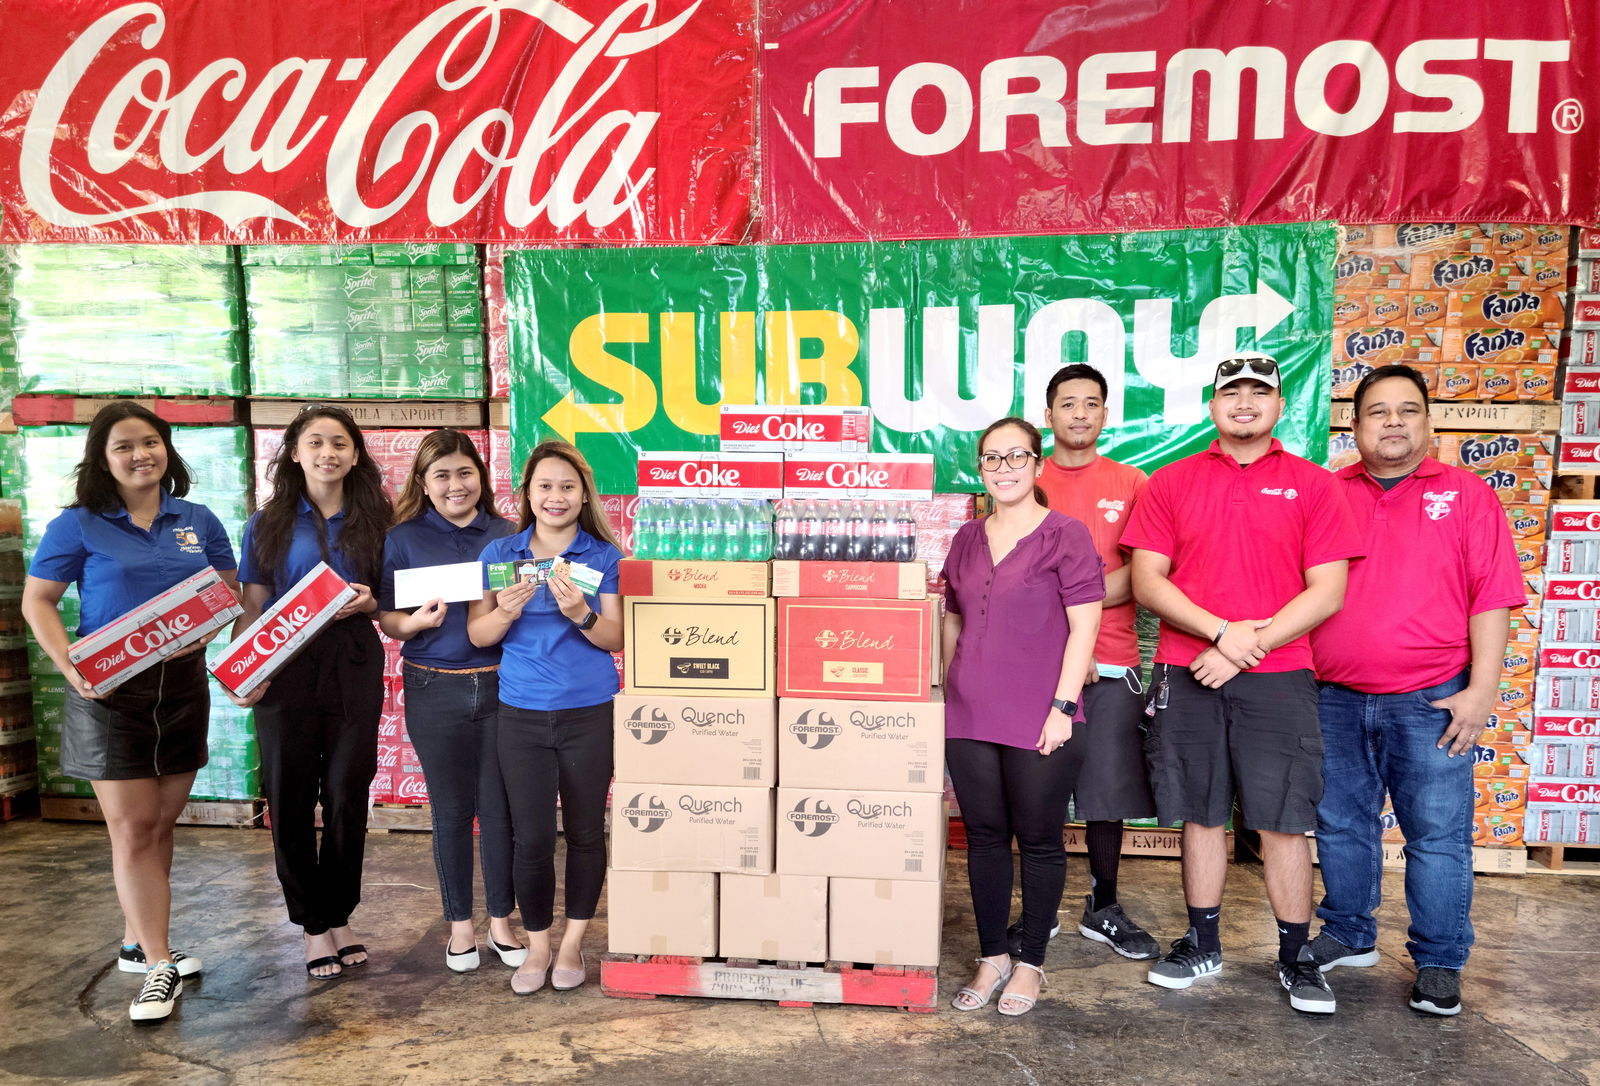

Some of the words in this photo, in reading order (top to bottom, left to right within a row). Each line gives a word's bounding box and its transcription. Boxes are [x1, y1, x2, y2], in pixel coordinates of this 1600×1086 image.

[812, 38, 1571, 159] FOREMOST
[19, 0, 700, 229] Coca-Cola
[1499, 232, 1524, 245] Fanta
[1537, 233, 1563, 246] Fanta
[1433, 255, 1494, 288] Fanta
[1535, 270, 1560, 282] Fanta
[345, 277, 374, 290] Sprite
[1375, 304, 1399, 315] Fanta
[1414, 304, 1439, 316] Fanta
[1482, 291, 1540, 320] Fanta
[348, 309, 378, 322] Sprite
[417, 342, 446, 357] Sprite
[1345, 328, 1405, 358] Fanta
[1466, 328, 1525, 359] Fanta
[541, 277, 1297, 435] SUBWAY
[419, 377, 448, 391] Sprite
[1446, 378, 1470, 389] Fanta
[1485, 378, 1509, 389] Fanta
[1524, 378, 1548, 390] Fanta
[1575, 377, 1597, 388] Diet
[390, 408, 446, 421] EXPORT
[732, 420, 760, 434] Diet
[762, 415, 825, 440] Coke
[1460, 435, 1520, 465] Fanta
[1570, 447, 1593, 458] Diet
[649, 467, 677, 480] Diet
[678, 462, 741, 486] Coke
[796, 468, 824, 481] Diet
[825, 463, 890, 488] Coke
[1484, 469, 1516, 490] nta
[1514, 518, 1539, 530] Fanta
[1561, 516, 1584, 527] Diet
[489, 564, 507, 572] Free
[683, 567, 719, 582] Blend
[838, 569, 876, 583] Blend
[1553, 585, 1577, 596] Diet
[1578, 581, 1600, 599] Co
[95, 650, 126, 672] Diet
[124, 613, 196, 657] Coke
[230, 651, 257, 675] Diet
[252, 605, 314, 656] Coke
[685, 626, 739, 647] Blend
[839, 629, 895, 650] Blend
[1503, 656, 1528, 669] Fanta
[1549, 653, 1572, 664] Diet
[1573, 649, 1600, 668] Co
[1501, 690, 1524, 703] Fanta
[681, 706, 745, 727] Quench
[849, 710, 916, 731] Quench
[627, 721, 673, 729] FOREMOST
[792, 725, 841, 734] FOREMOST
[1544, 721, 1567, 732] Diet
[691, 728, 717, 737] Purified
[718, 729, 739, 737] Water
[860, 732, 886, 740] Purified
[1495, 792, 1519, 804] Fanta
[1538, 787, 1560, 798] Diet
[678, 794, 742, 815] Quench
[846, 798, 912, 819] Quench
[624, 809, 670, 817] FOREMOST
[790, 813, 838, 821] FOREMOST
[688, 816, 714, 825] Purified
[715, 817, 736, 825] Water
[857, 820, 883, 829] Purified
[885, 821, 906, 829] Water
[1492, 825, 1516, 837] Fanta
[1132, 835, 1182, 849] EXPOR
